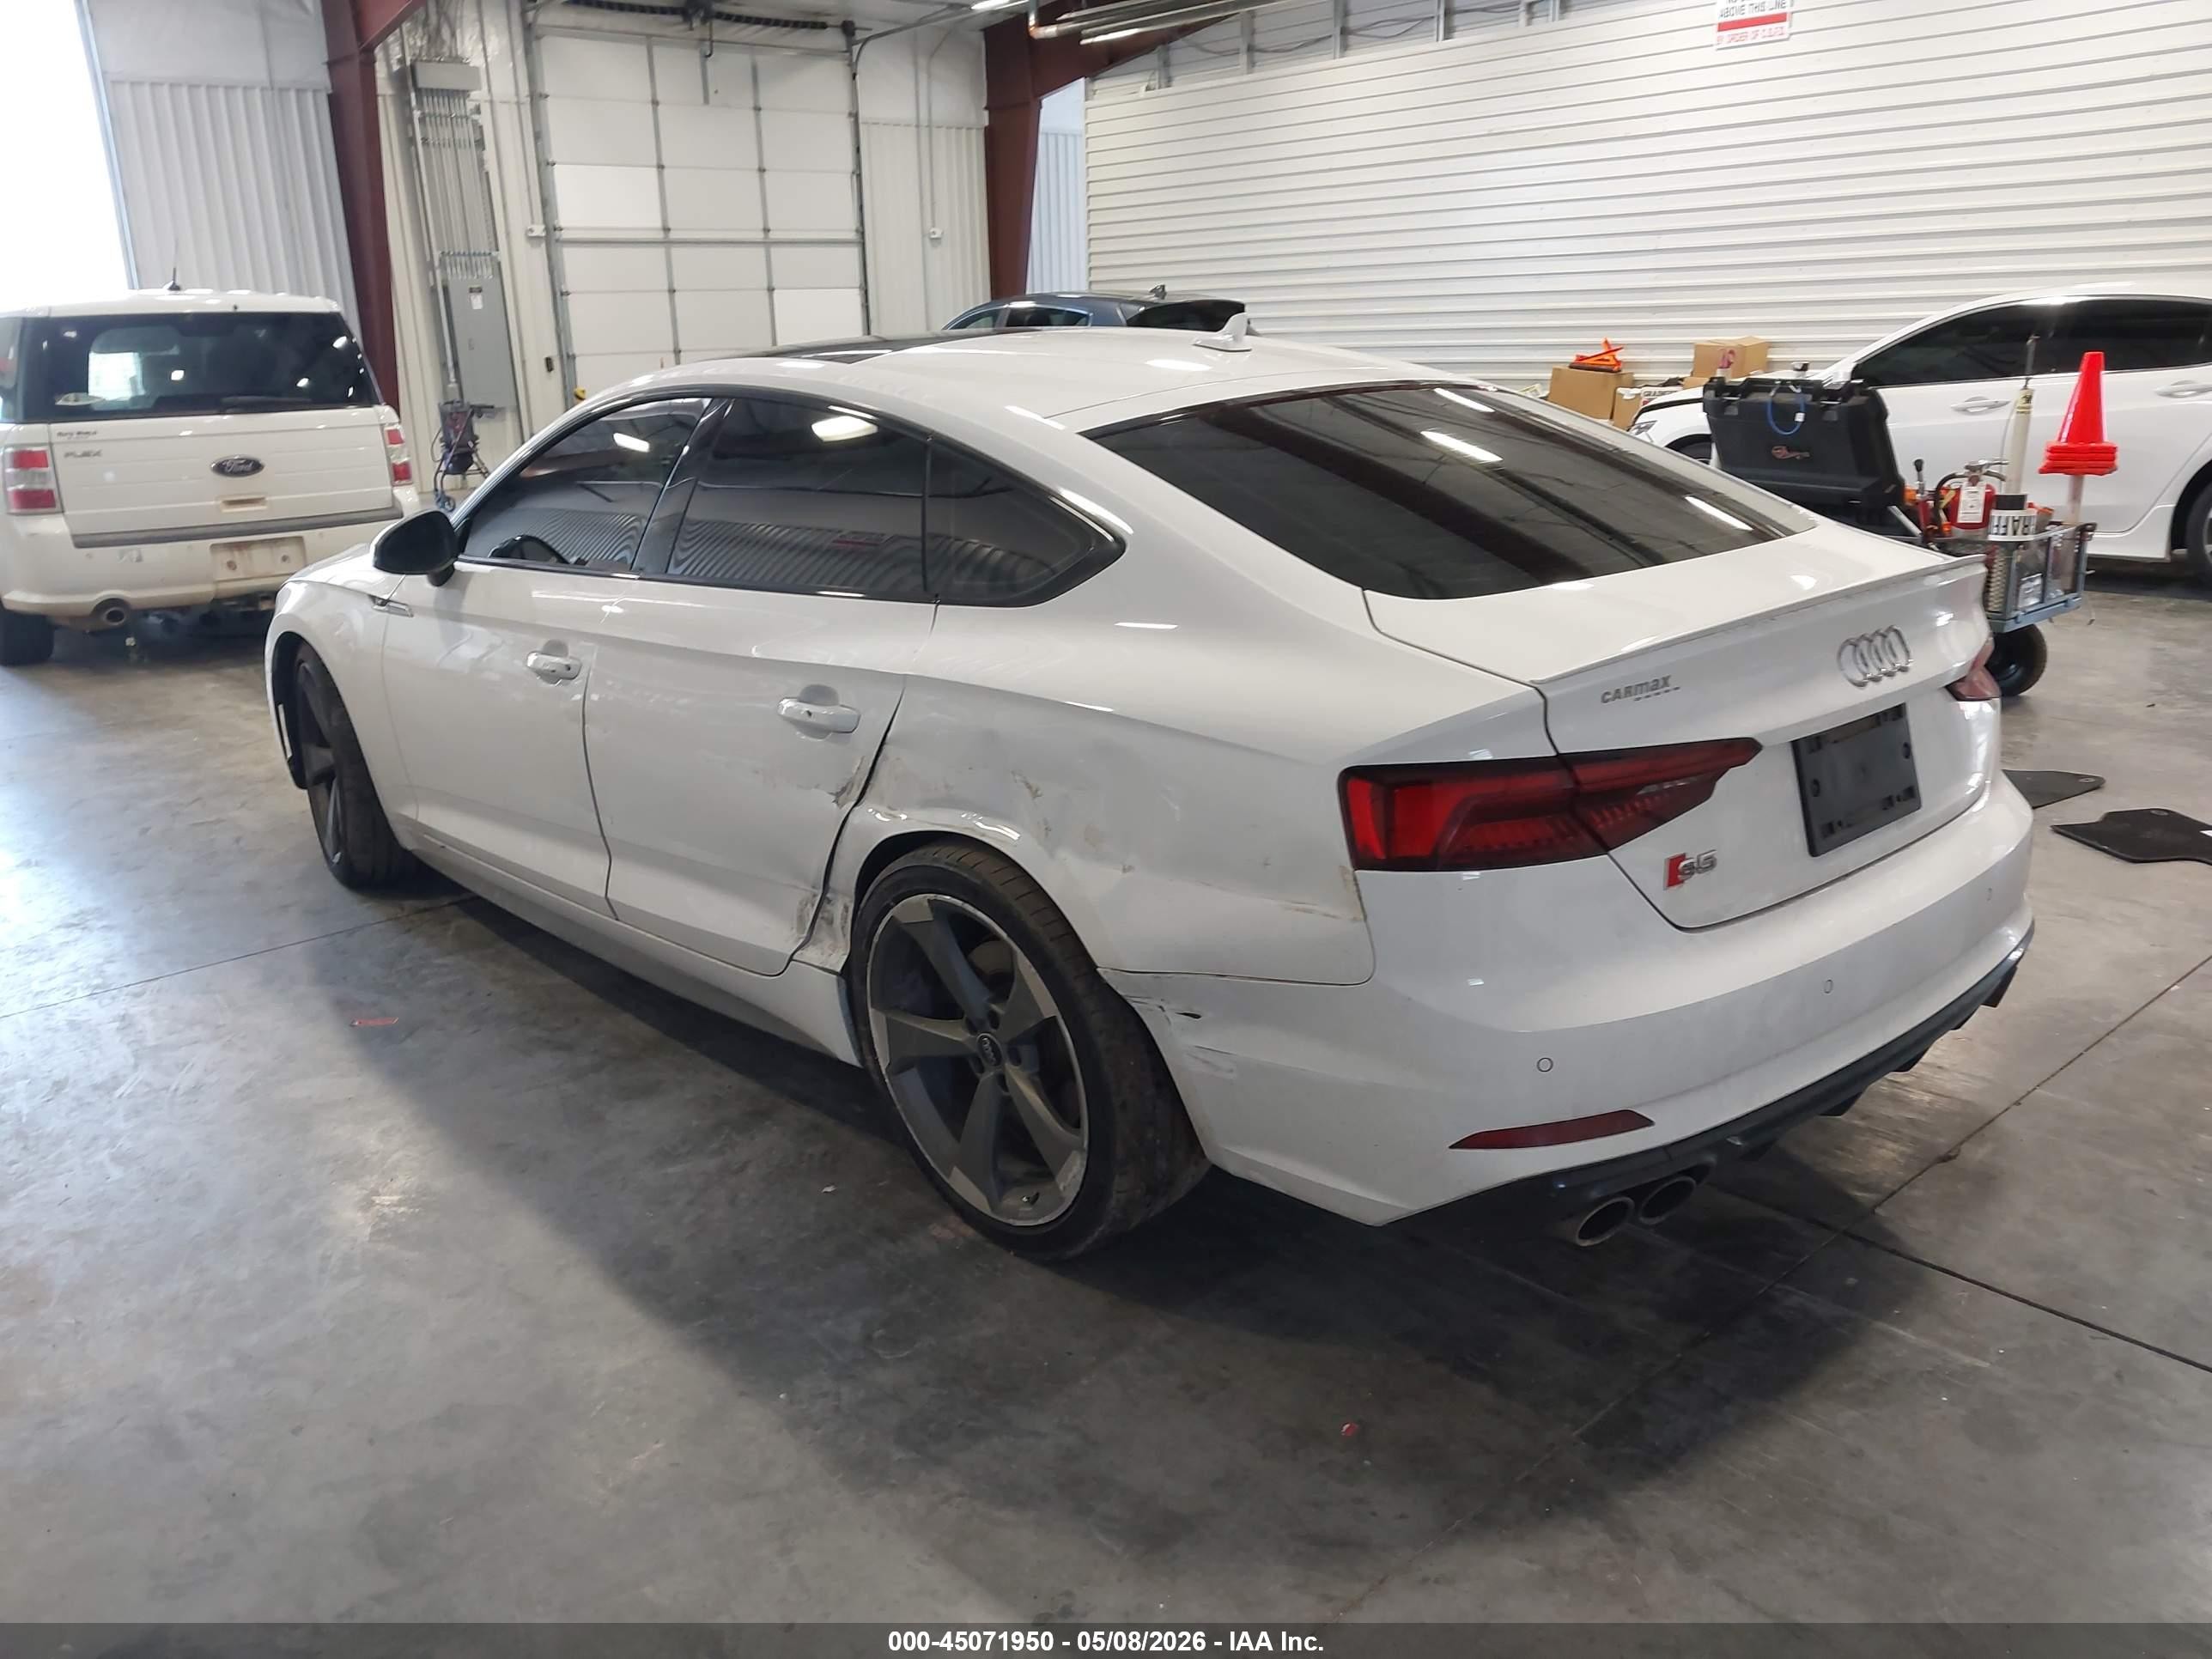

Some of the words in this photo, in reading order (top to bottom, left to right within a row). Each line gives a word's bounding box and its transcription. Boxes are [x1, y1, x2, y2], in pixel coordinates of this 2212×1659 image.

[1718, 4, 1745, 18] ABOVE
[1749, 1, 1766, 14] THIS
[1768, 0, 1787, 11] LINE
[1676, 848, 1718, 882] S5
